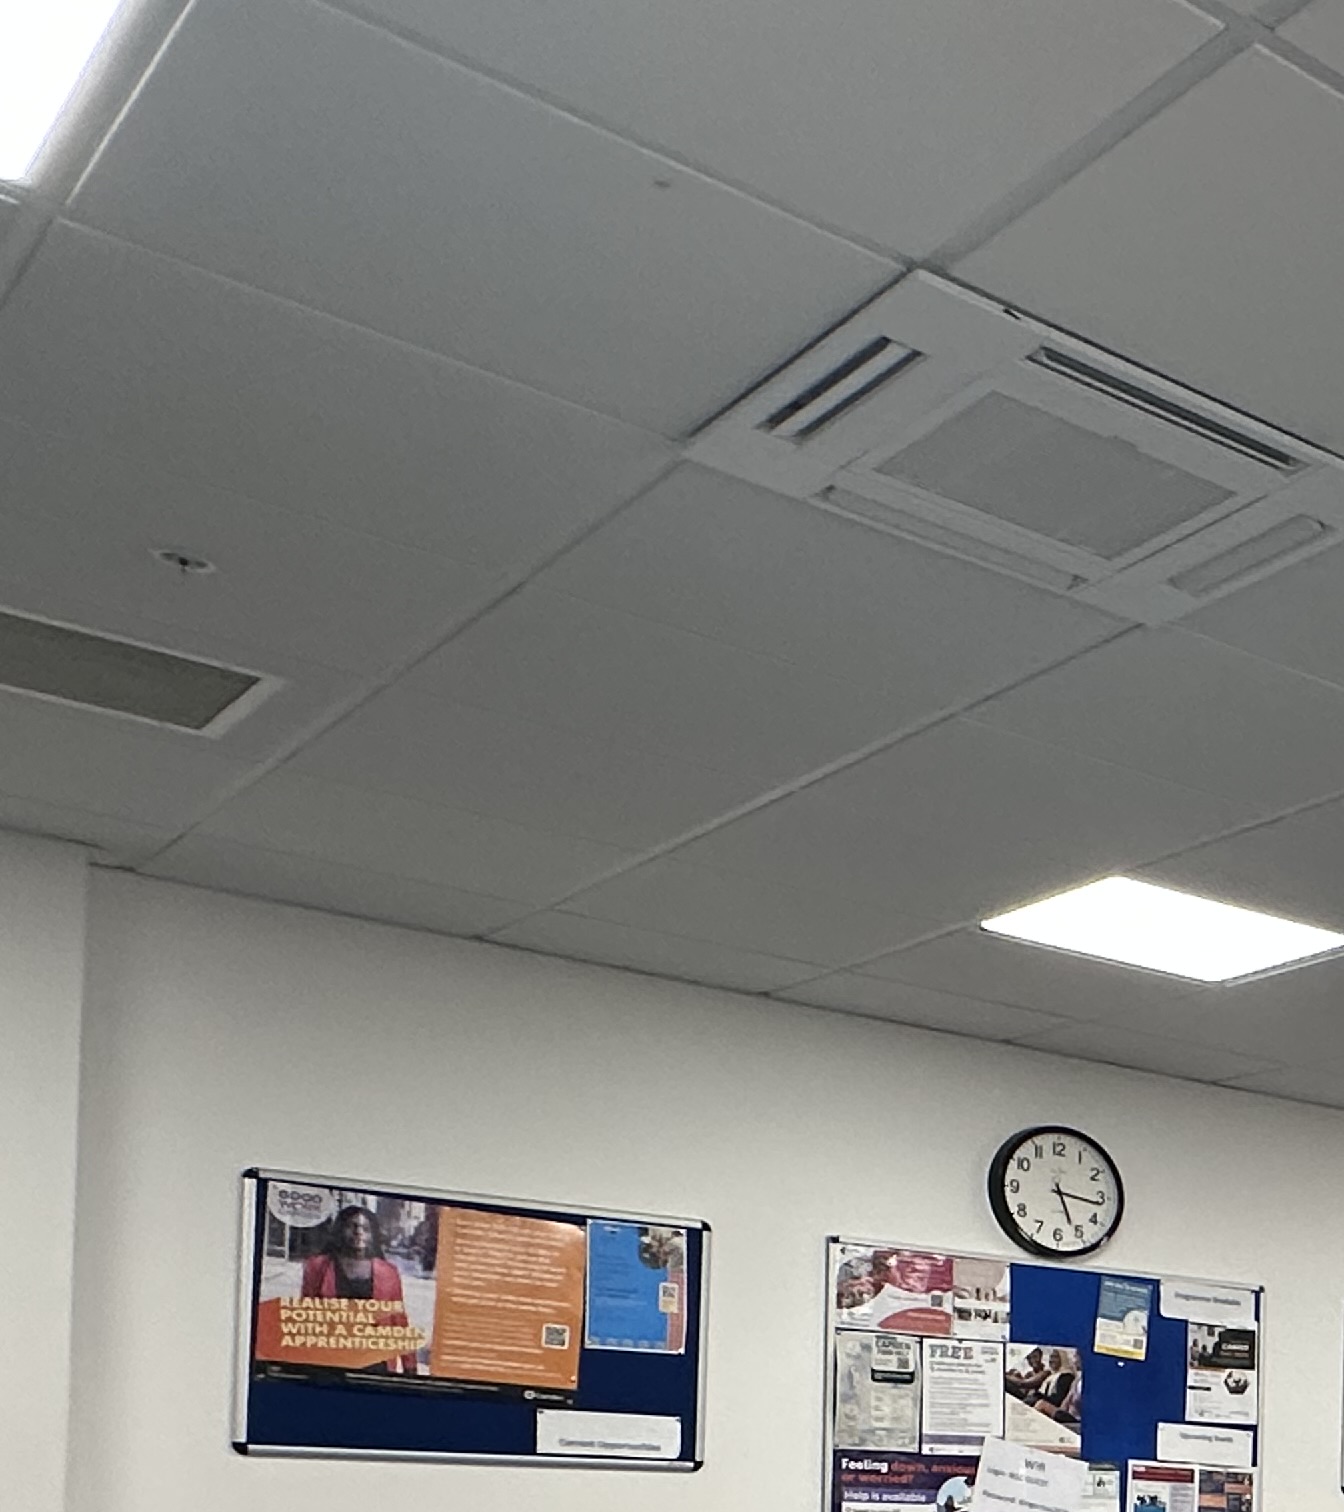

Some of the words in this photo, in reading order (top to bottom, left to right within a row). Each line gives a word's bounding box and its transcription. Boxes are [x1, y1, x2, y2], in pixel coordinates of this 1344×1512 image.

[1034, 1144, 1044, 1159] 11
[1052, 1142, 1066, 1157] 12
[1016, 1156, 1031, 1172] 10
[1078, 1150, 1082, 1165] 1
[1089, 1167, 1101, 1181] 2
[1009, 1178, 1020, 1193] 9
[1096, 1190, 1105, 1206] 3
[1016, 1203, 1028, 1218] 8
[1034, 1219, 1044, 1234] 7
[1088, 1212, 1098, 1226] 4
[1052, 1228, 1064, 1241] 6
[1074, 1225, 1083, 1239] 5
[280, 1297, 350, 1311] REALISE
[354, 1299, 405, 1313] YOUR
[280, 1309, 377, 1324] POTENTIAL
[281, 1322, 329, 1335] WITH
[335, 1324, 348, 1335] A
[353, 1324, 426, 1339] CAMDEN
[280, 1335, 428, 1351] APPRENTICESHIP
[928, 1344, 975, 1360] FREE
[840, 1458, 889, 1474] Feeling
[843, 1490, 870, 1502] Help
[871, 1490, 880, 1501] is
[882, 1492, 927, 1503] available
